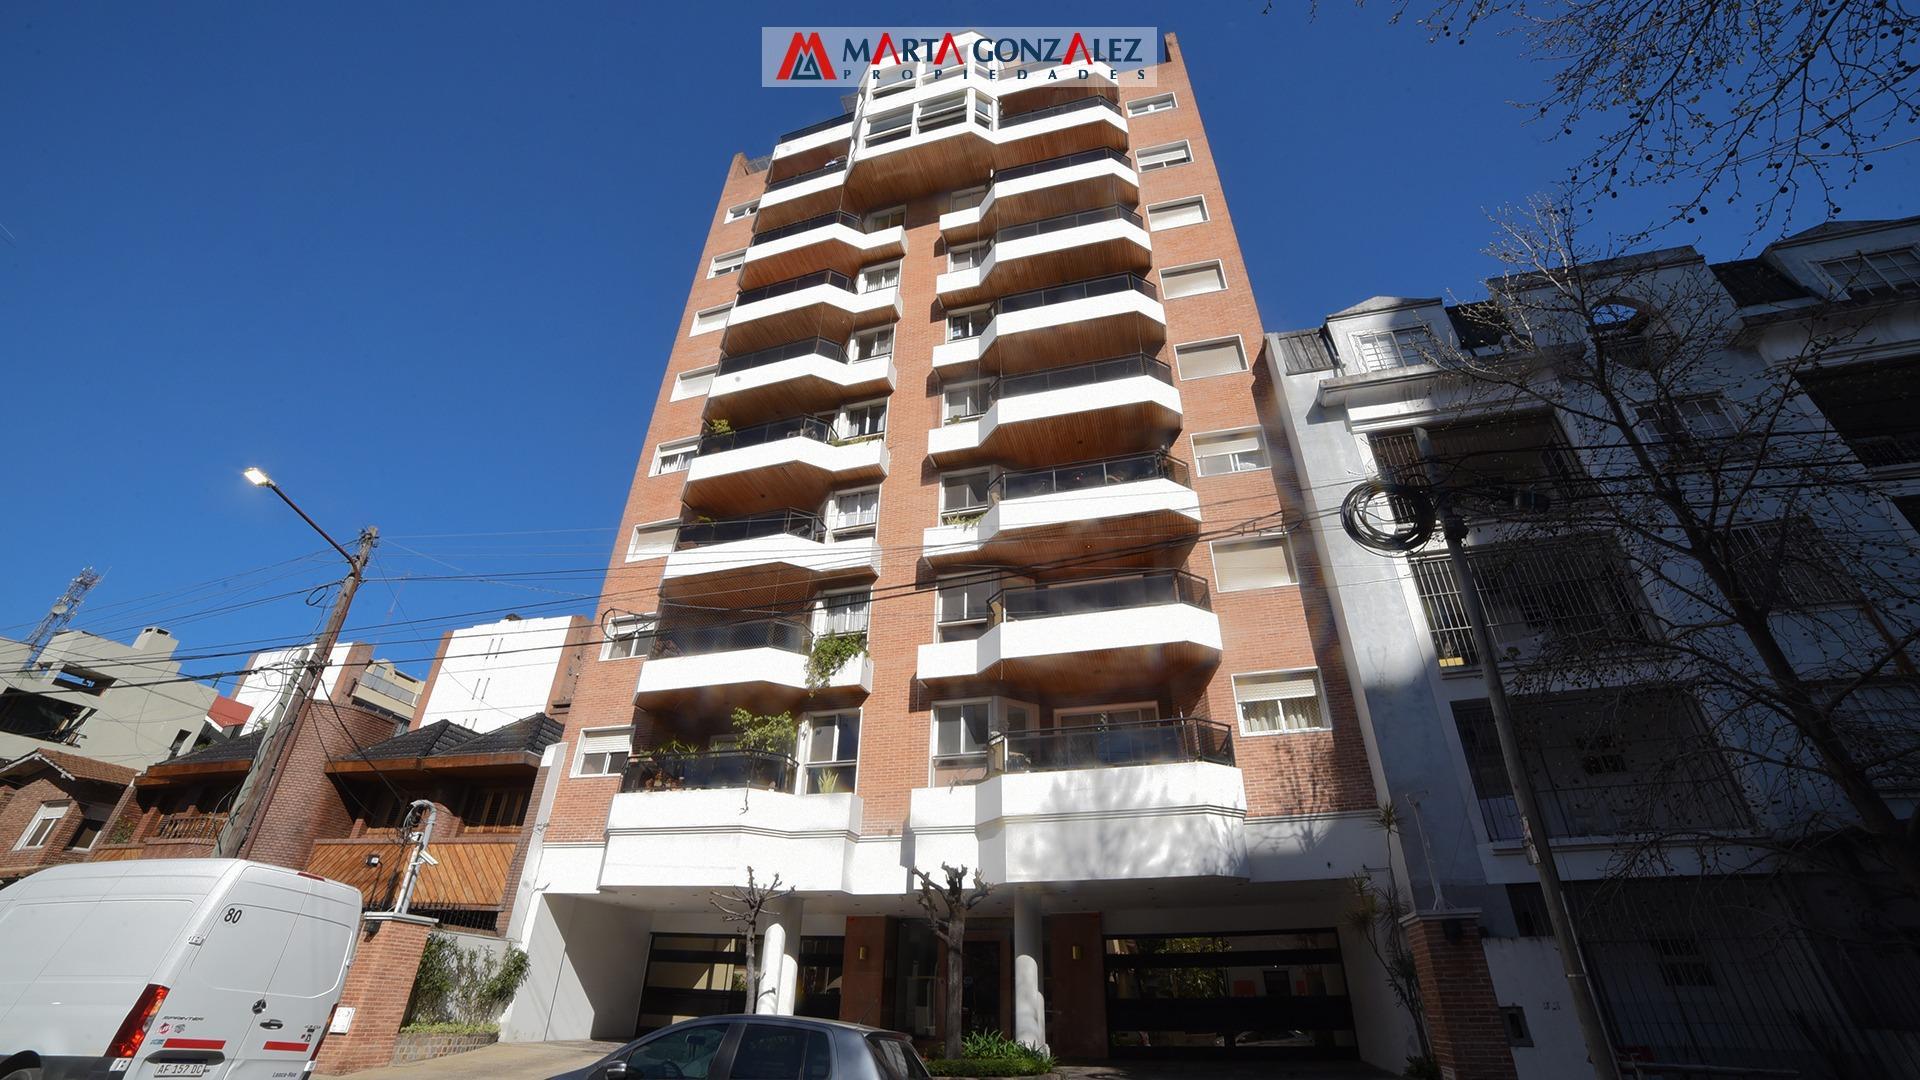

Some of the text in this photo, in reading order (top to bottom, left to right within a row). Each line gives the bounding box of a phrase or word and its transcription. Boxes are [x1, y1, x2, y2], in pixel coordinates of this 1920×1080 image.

[224, 908, 242, 924] 80
[157, 1064, 171, 1074] AF
[172, 1064, 190, 1074] 157
